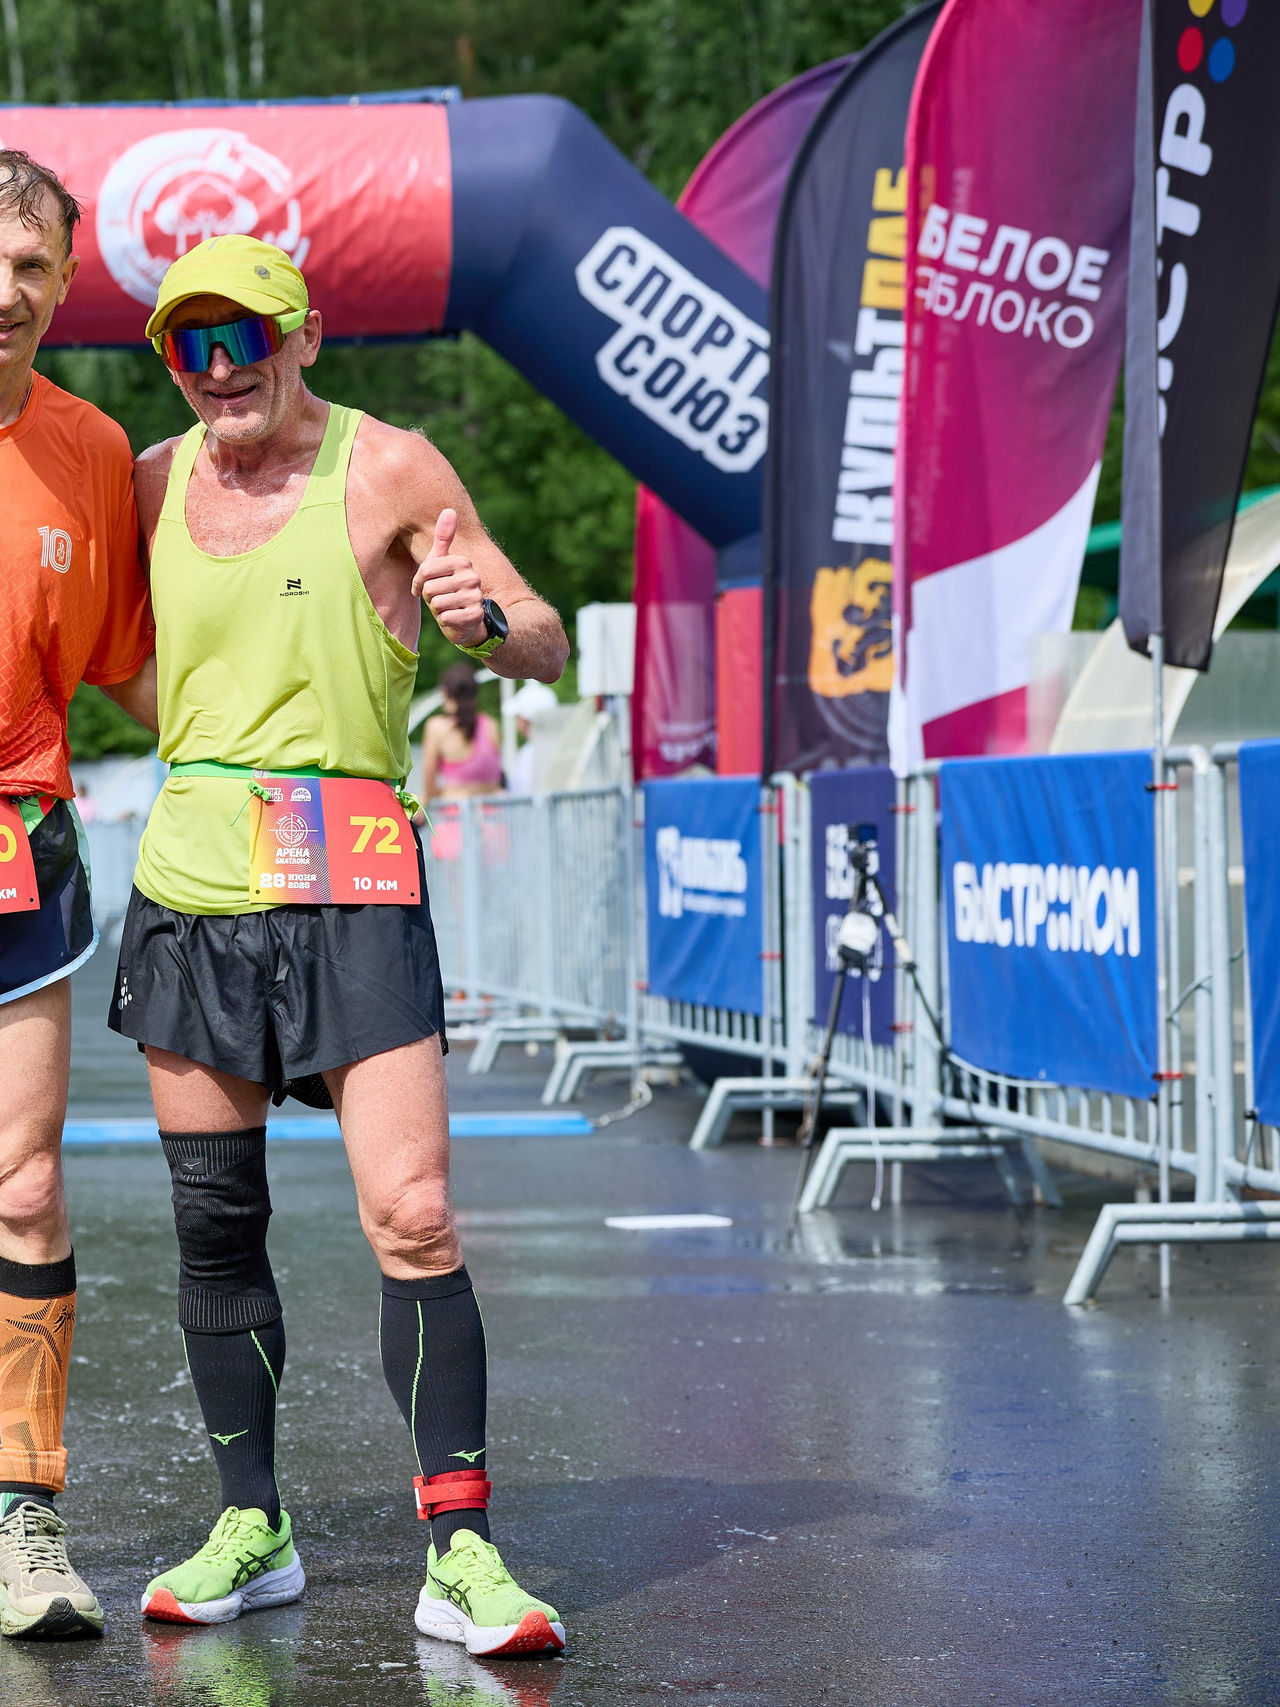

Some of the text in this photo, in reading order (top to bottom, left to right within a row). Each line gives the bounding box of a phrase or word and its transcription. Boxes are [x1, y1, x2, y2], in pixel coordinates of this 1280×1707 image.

[917, 203, 1111, 302] БЕЛОЕ
[594, 244, 771, 383] СПОРТ
[614, 334, 761, 454] СОЮЗ
[37, 525, 73, 574] 10
[275, 847, 310, 857] АРЕНА
[349, 816, 402, 854] 72
[260, 872, 285, 888] 28
[352, 877, 371, 891] 10
